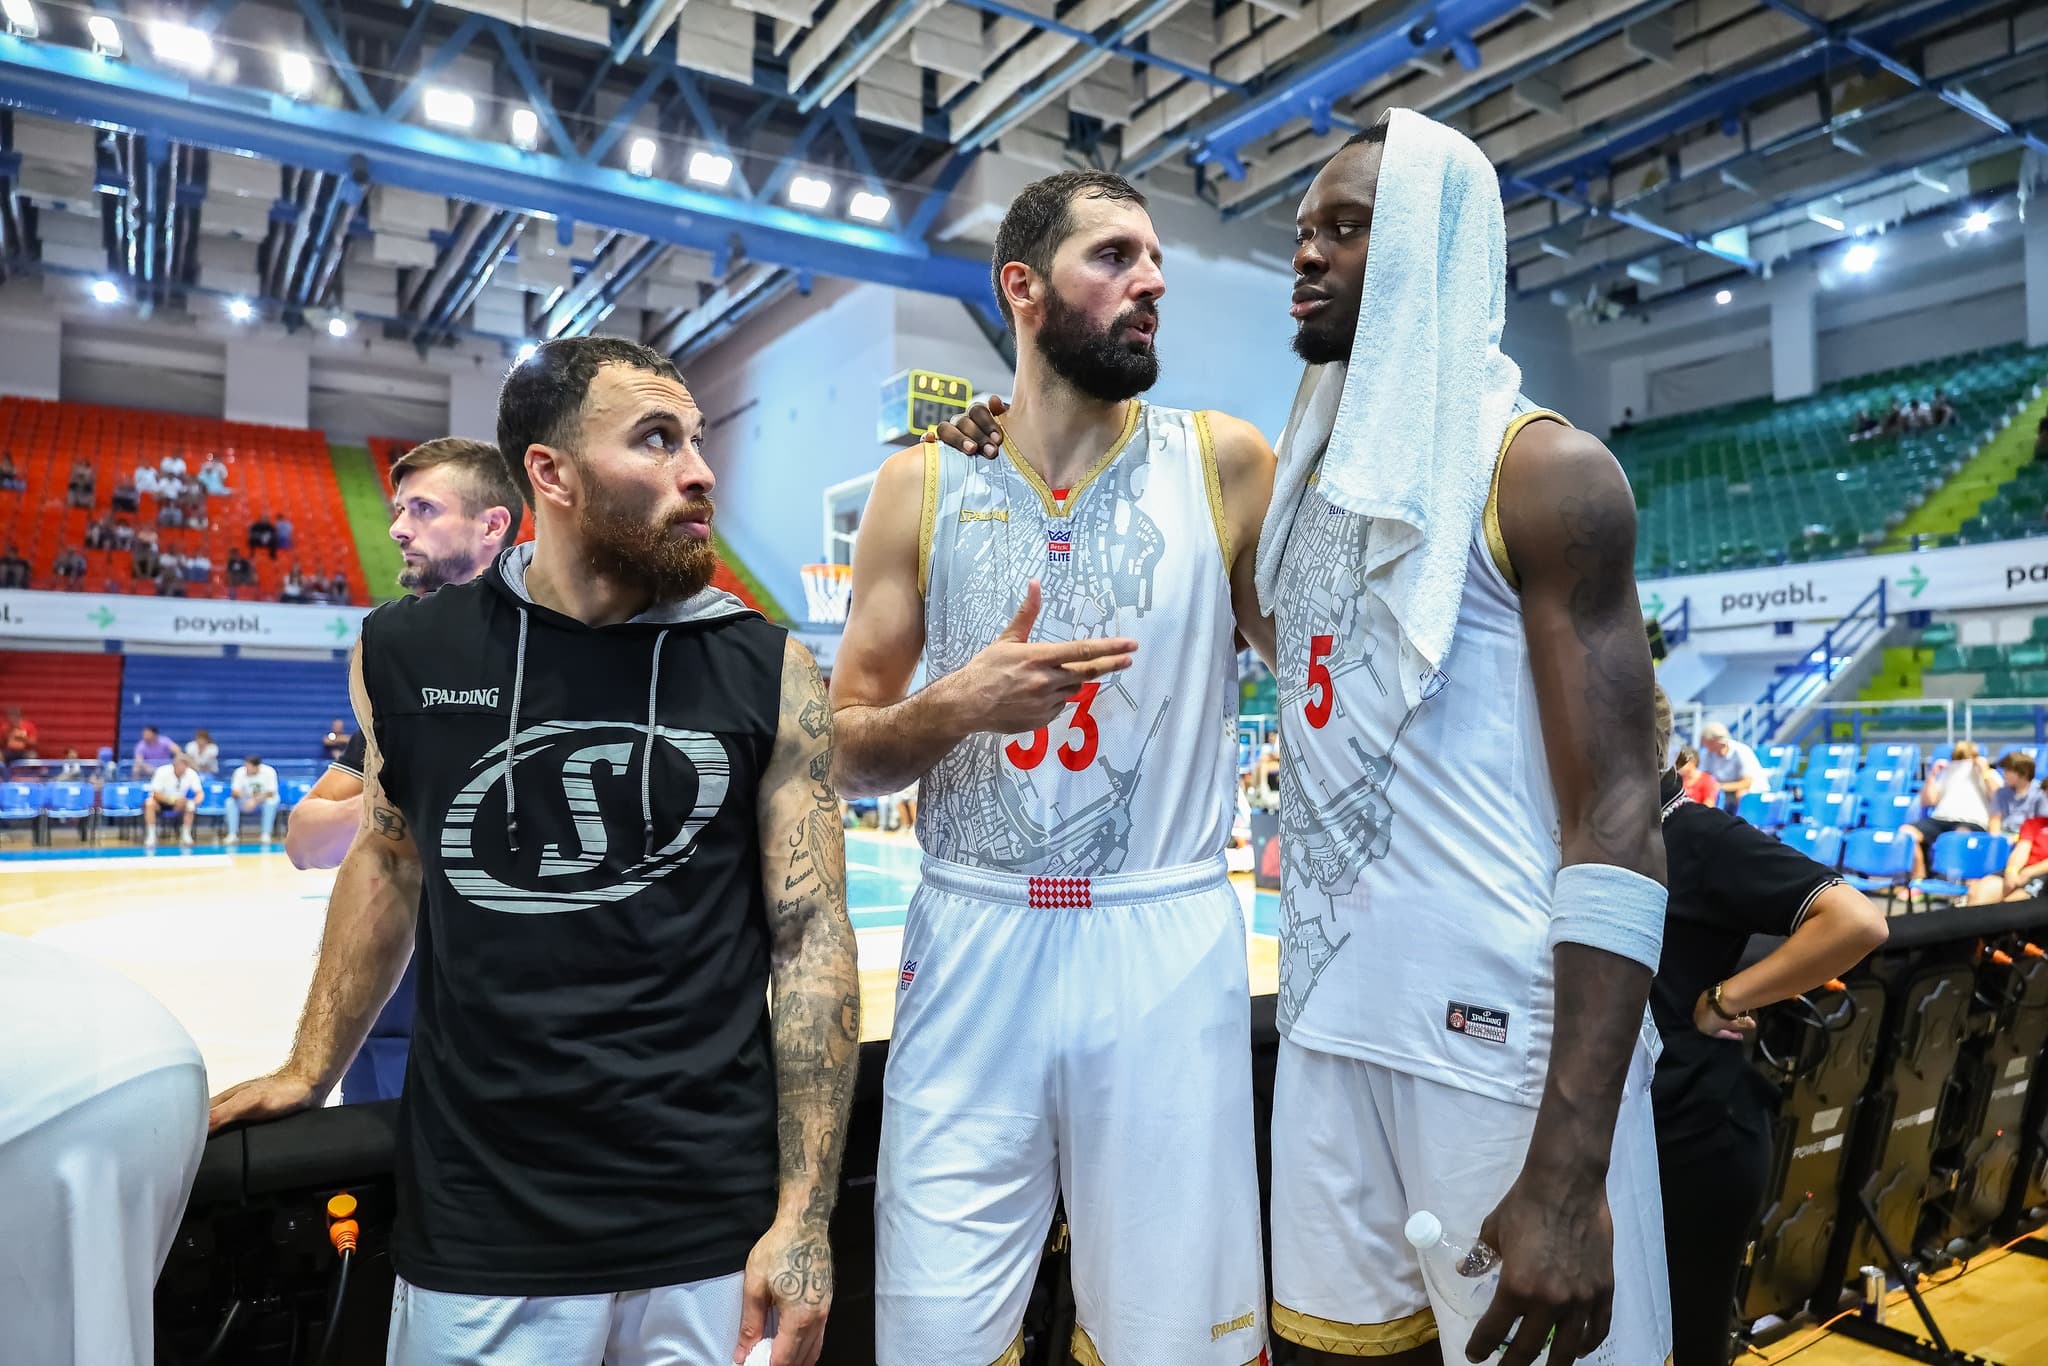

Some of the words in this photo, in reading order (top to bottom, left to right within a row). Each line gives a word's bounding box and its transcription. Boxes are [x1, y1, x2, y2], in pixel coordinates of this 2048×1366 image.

[1049, 552, 1071, 562] ELITE
[1720, 580, 1828, 615] payabl.
[174, 613, 272, 636] payabl.
[1304, 634, 1335, 730] 5
[421, 687, 500, 709] SPALDING
[1471, 1013, 1502, 1026] SPALDING
[1210, 1310, 1255, 1343] SPALDING
